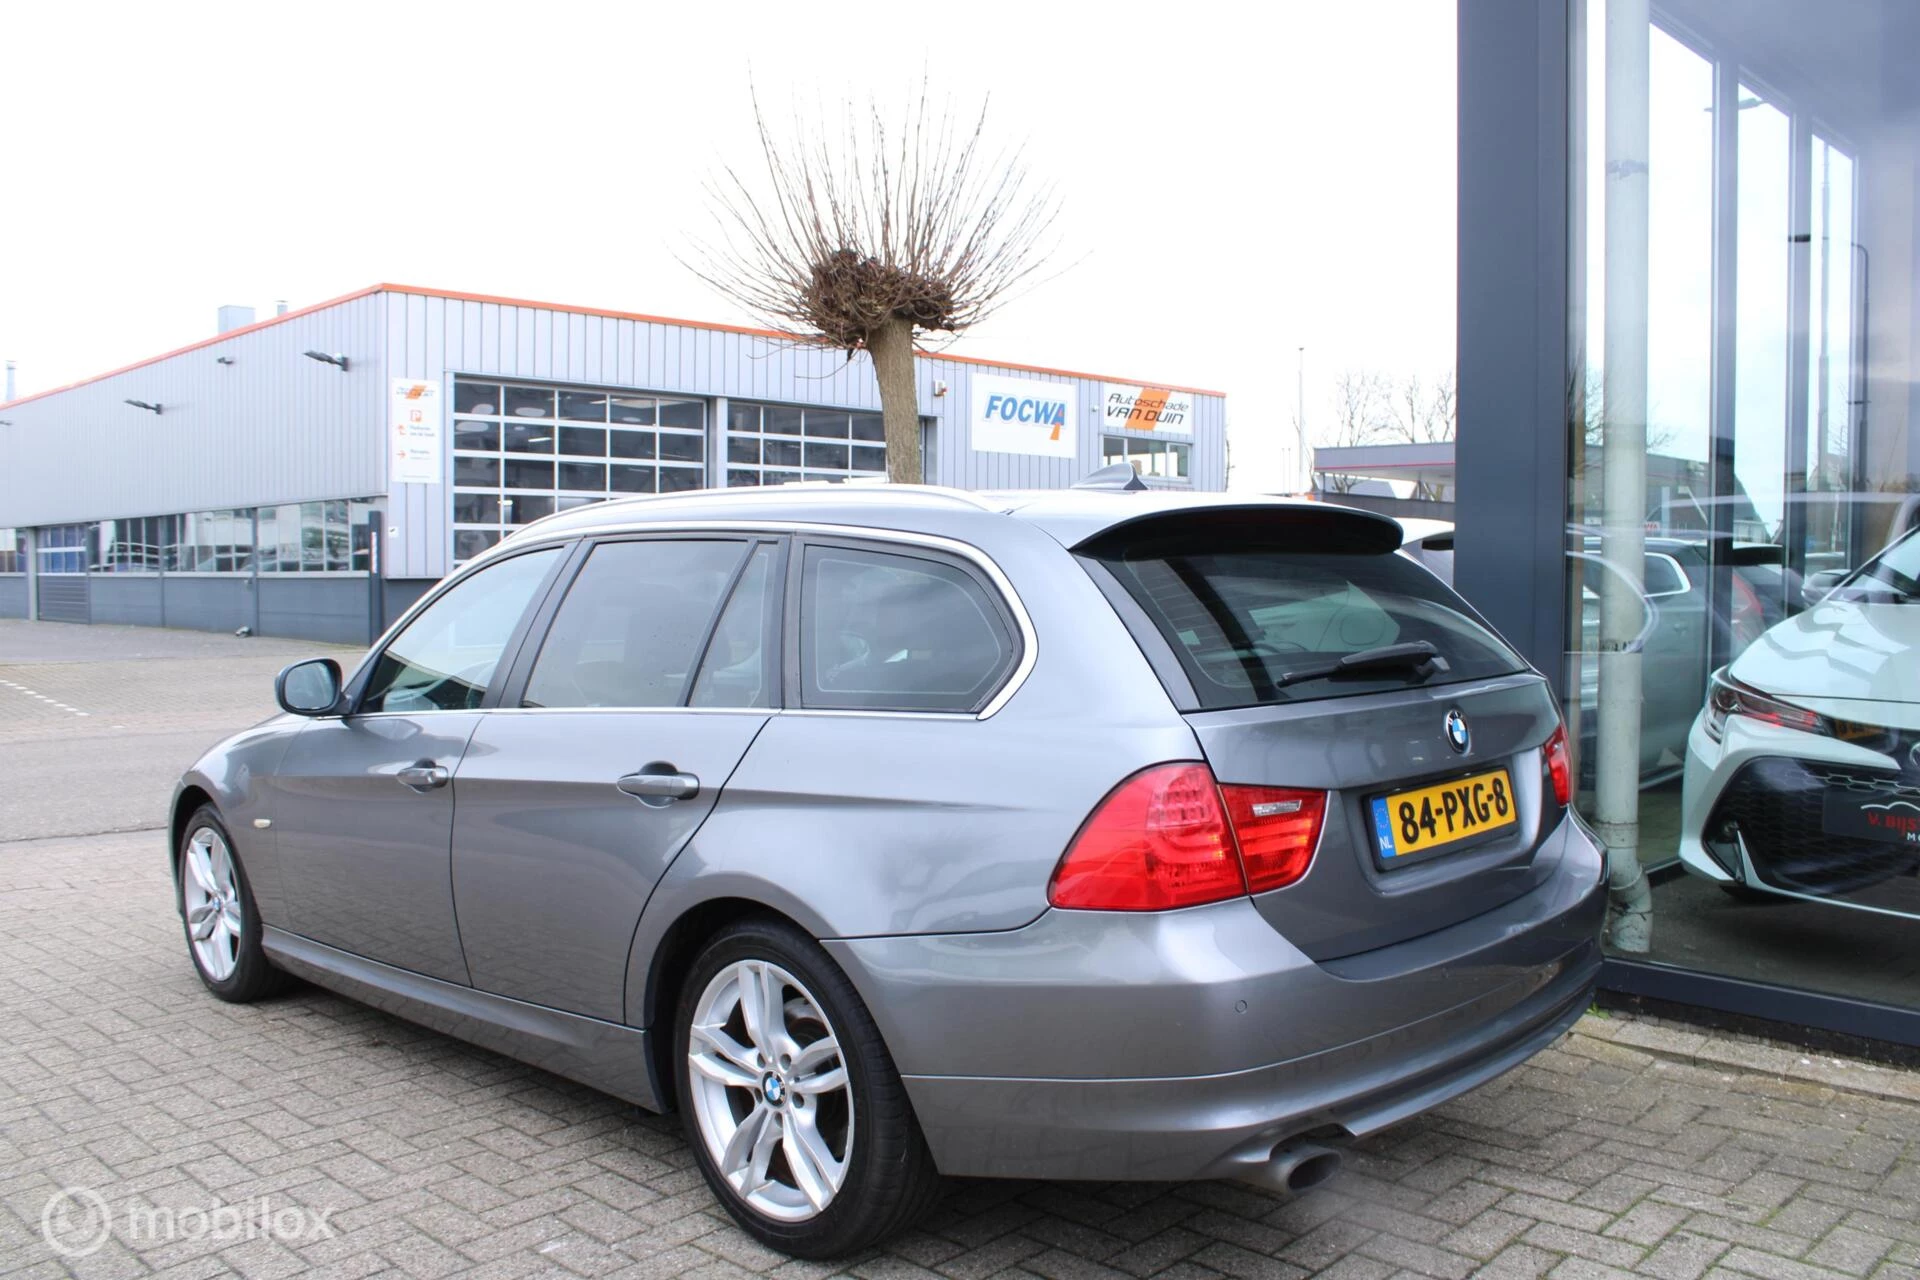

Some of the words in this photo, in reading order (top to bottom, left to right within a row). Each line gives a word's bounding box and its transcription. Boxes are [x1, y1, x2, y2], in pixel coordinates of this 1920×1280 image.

[985, 394, 1066, 430] FOCWA
[1107, 393, 1189, 412] Autoschade
[1107, 405, 1141, 420] VAN
[1143, 411, 1184, 425] DUIN
[1399, 778, 1508, 844] 84-PXG-8
[1379, 836, 1393, 849] NL
